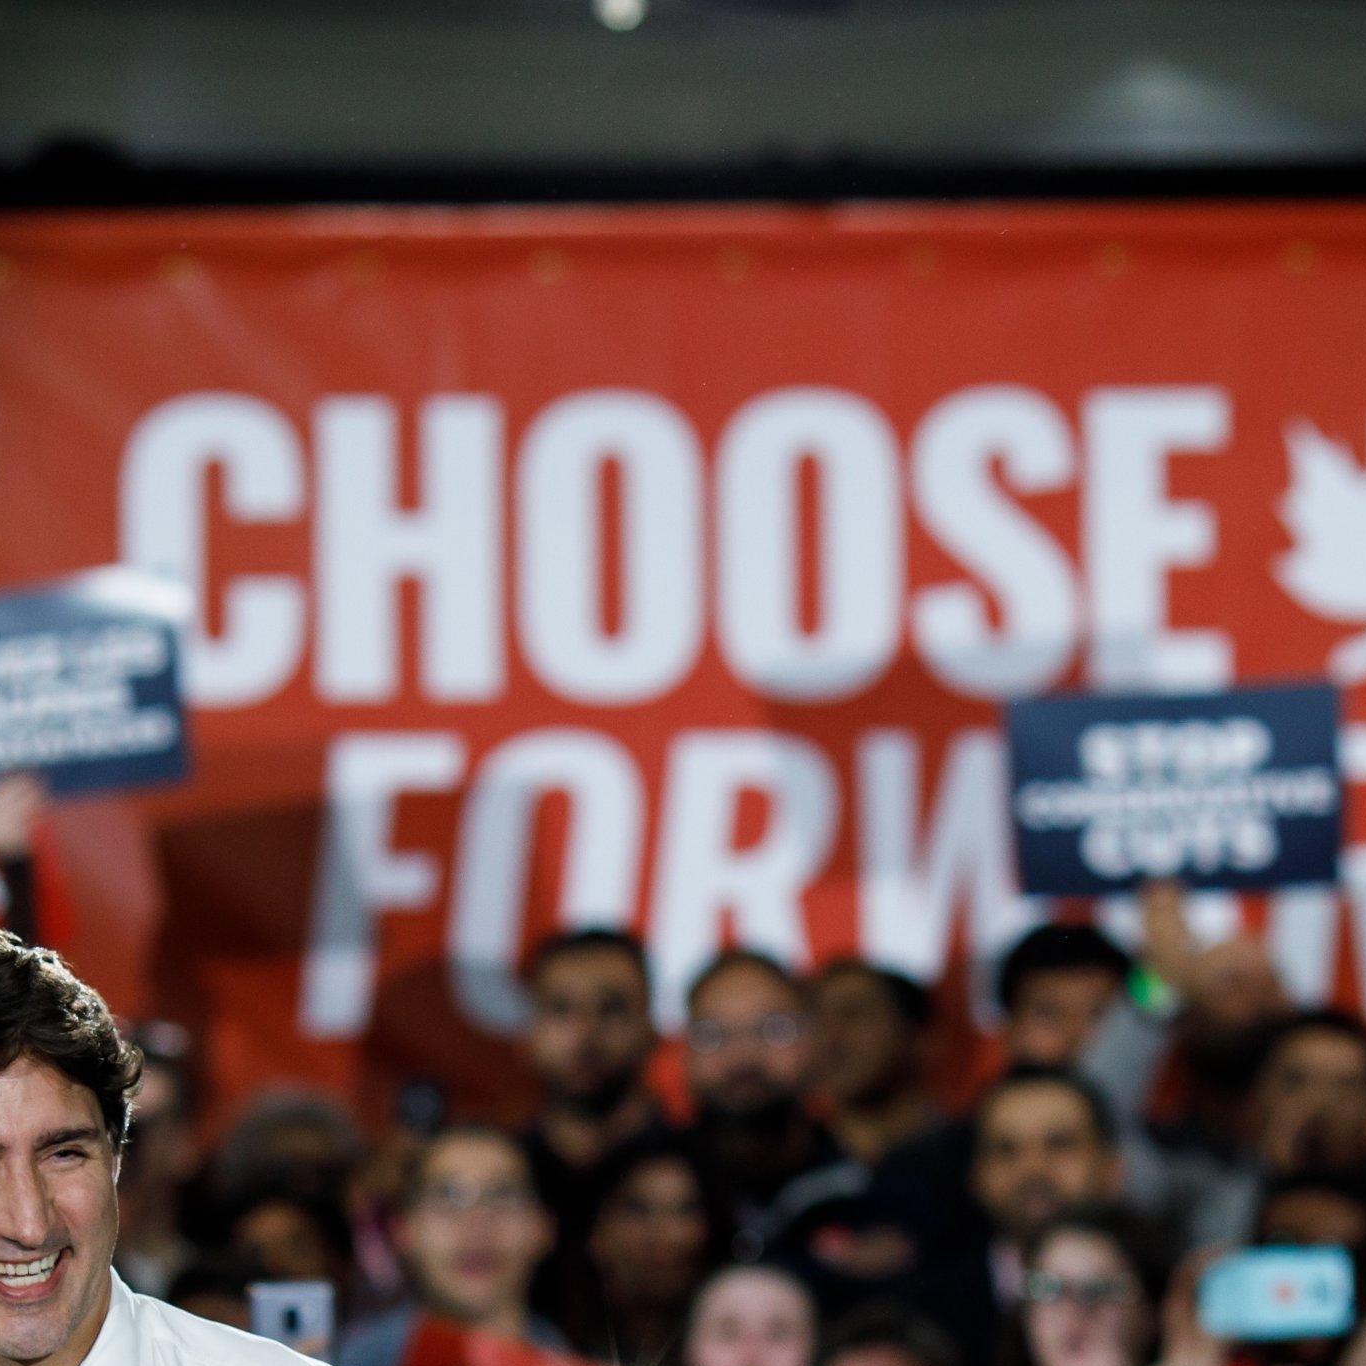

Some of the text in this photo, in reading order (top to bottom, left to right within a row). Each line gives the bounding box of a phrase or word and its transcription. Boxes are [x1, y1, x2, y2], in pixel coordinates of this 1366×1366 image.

[121, 387, 1231, 704] CHOOSE
[1081, 721, 1269, 787] STOP
[1082, 811, 1275, 873] CUTS
